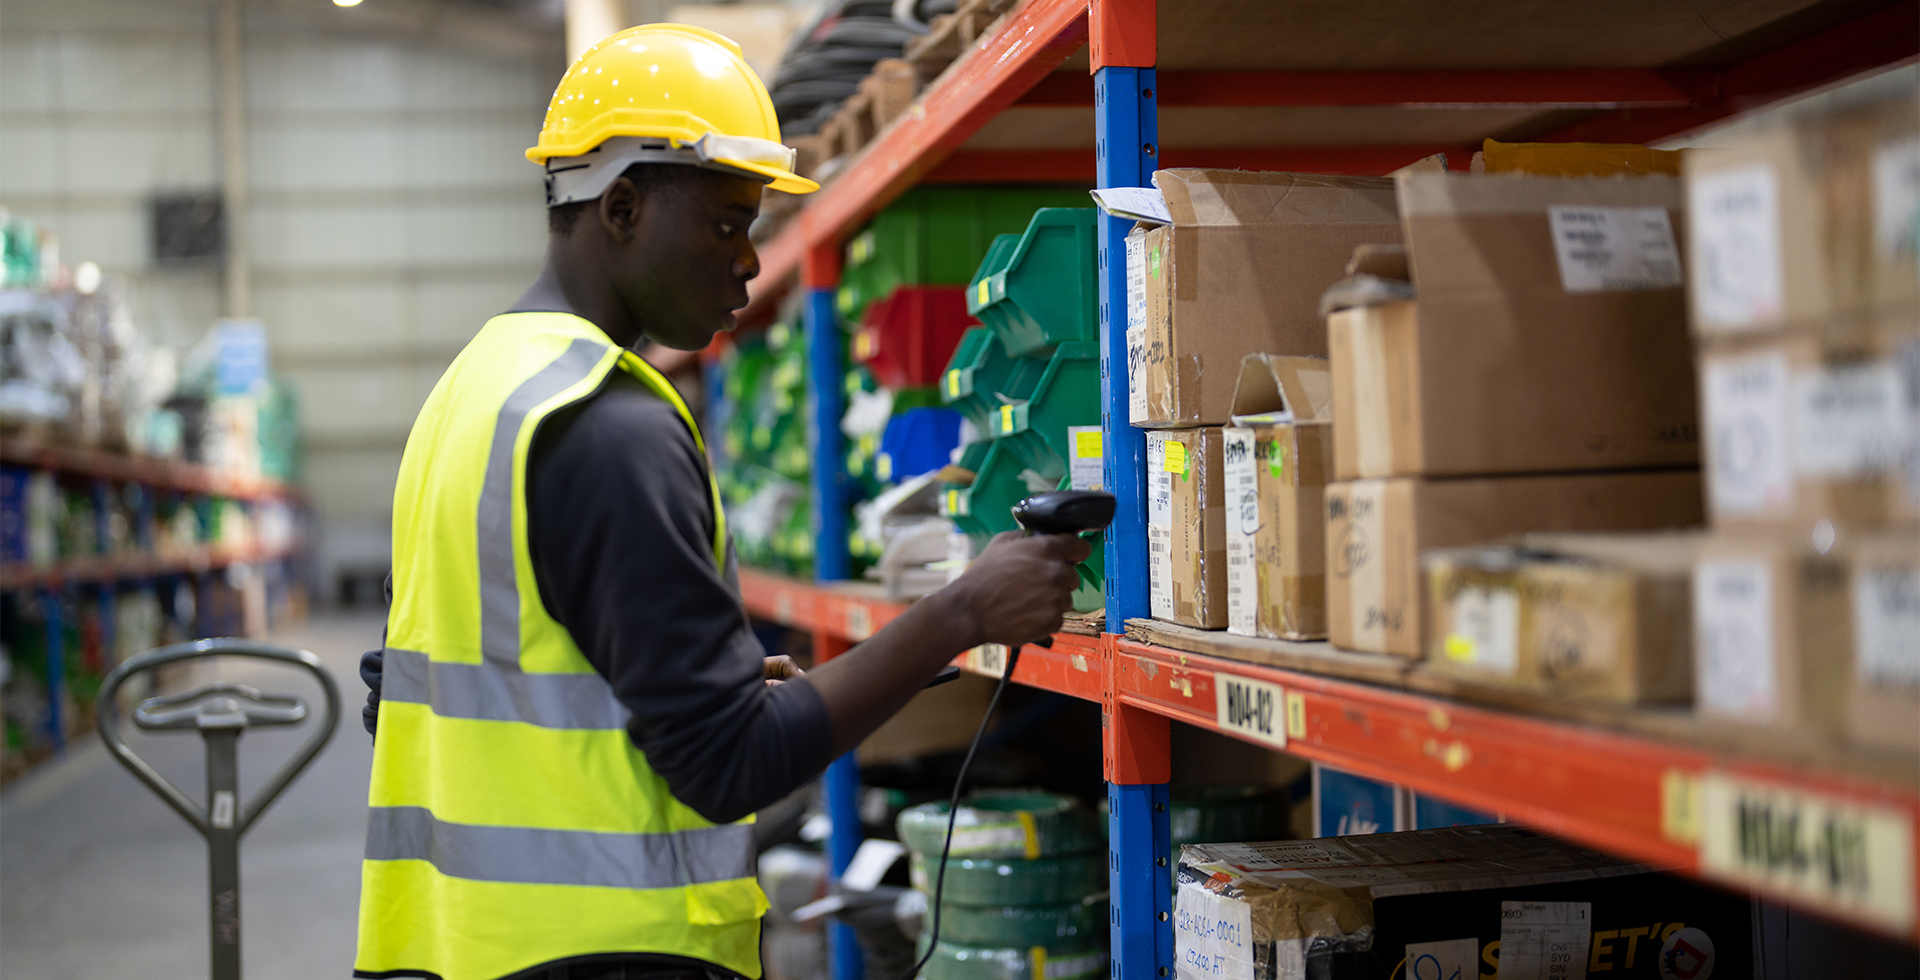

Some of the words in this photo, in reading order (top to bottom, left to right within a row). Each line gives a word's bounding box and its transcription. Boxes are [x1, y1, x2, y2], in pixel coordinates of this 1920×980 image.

[1580, 909, 1586, 920] 1
[1551, 943, 1568, 951] CNS
[1551, 953, 1571, 962] SYD
[1549, 965, 1566, 973] SIN
